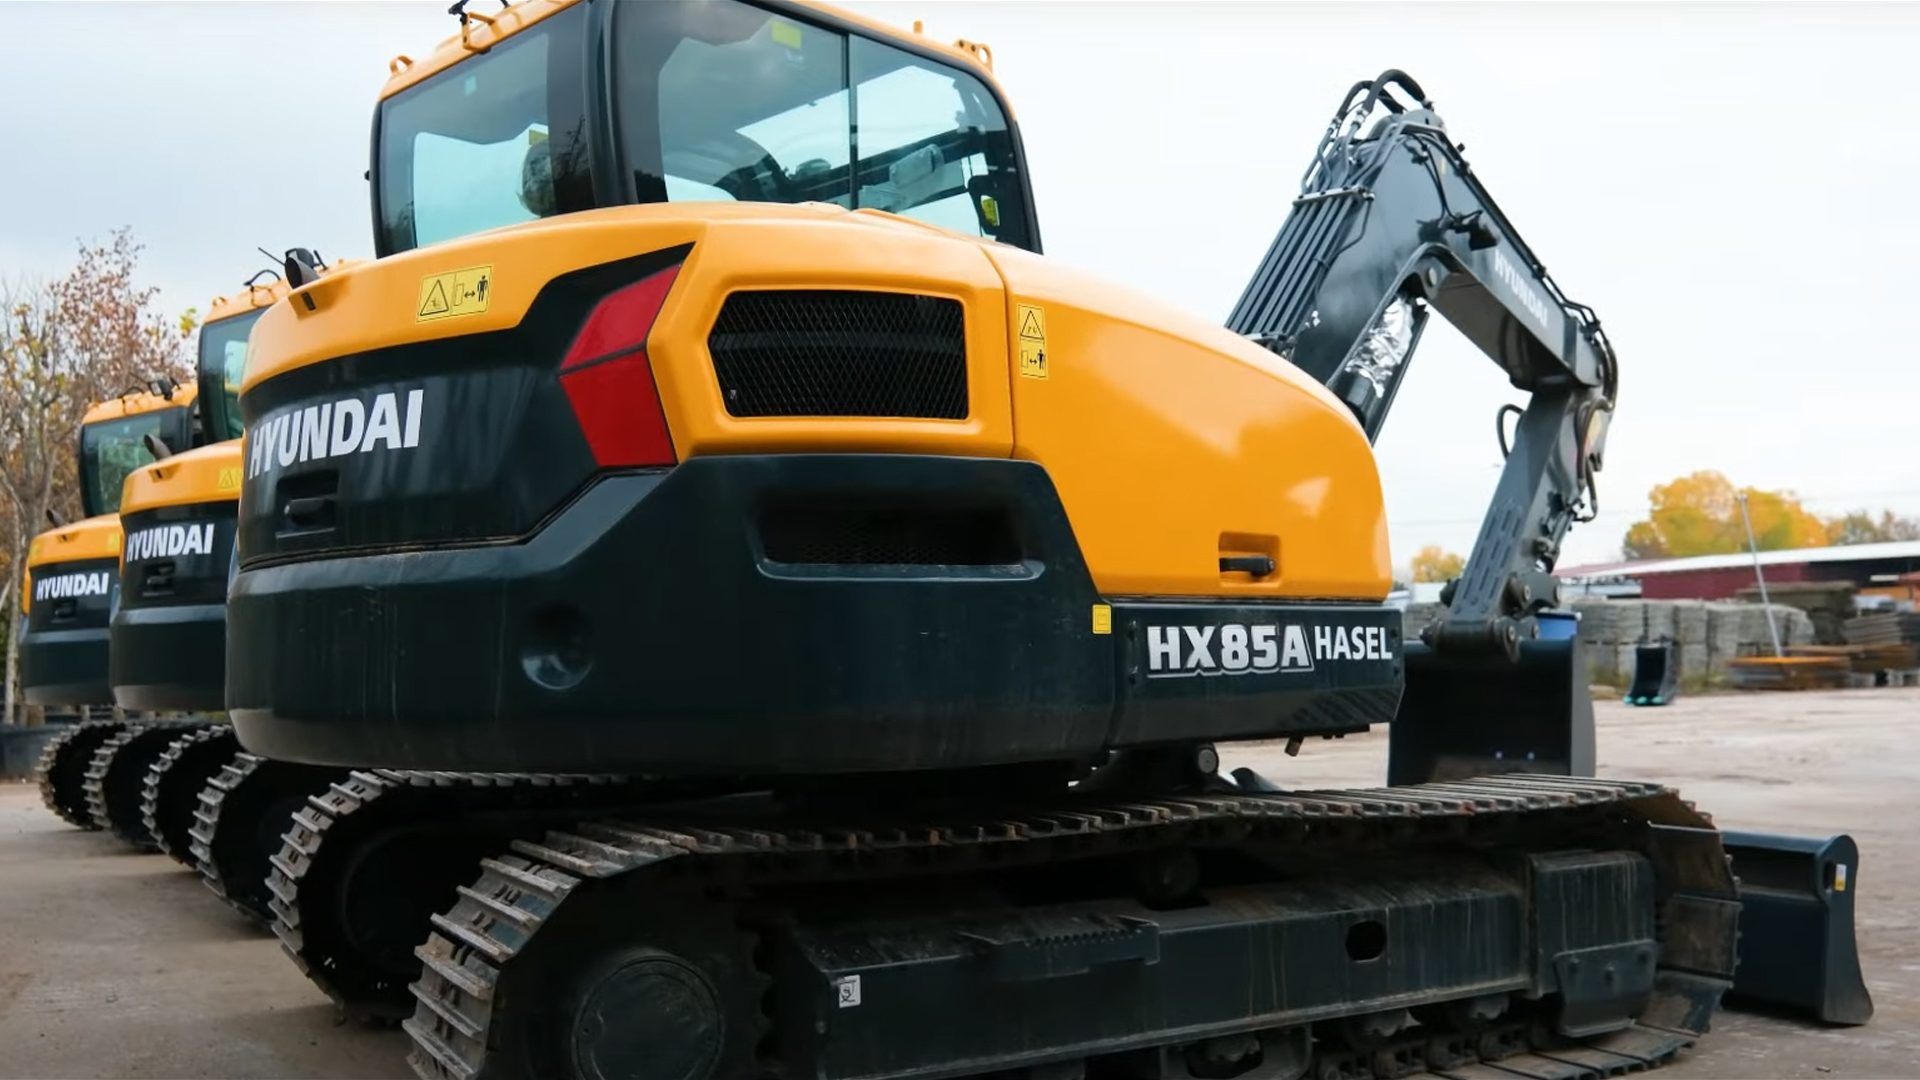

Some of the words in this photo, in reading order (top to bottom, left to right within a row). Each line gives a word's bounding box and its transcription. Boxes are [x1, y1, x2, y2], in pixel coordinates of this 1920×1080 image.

[248, 389, 425, 480] HYUNDAI
[126, 523, 215, 563] HYUNDAI
[36, 572, 110, 601] HYUNDAI
[1147, 624, 1313, 675] HX85A
[1314, 626, 1393, 660] HASEL
